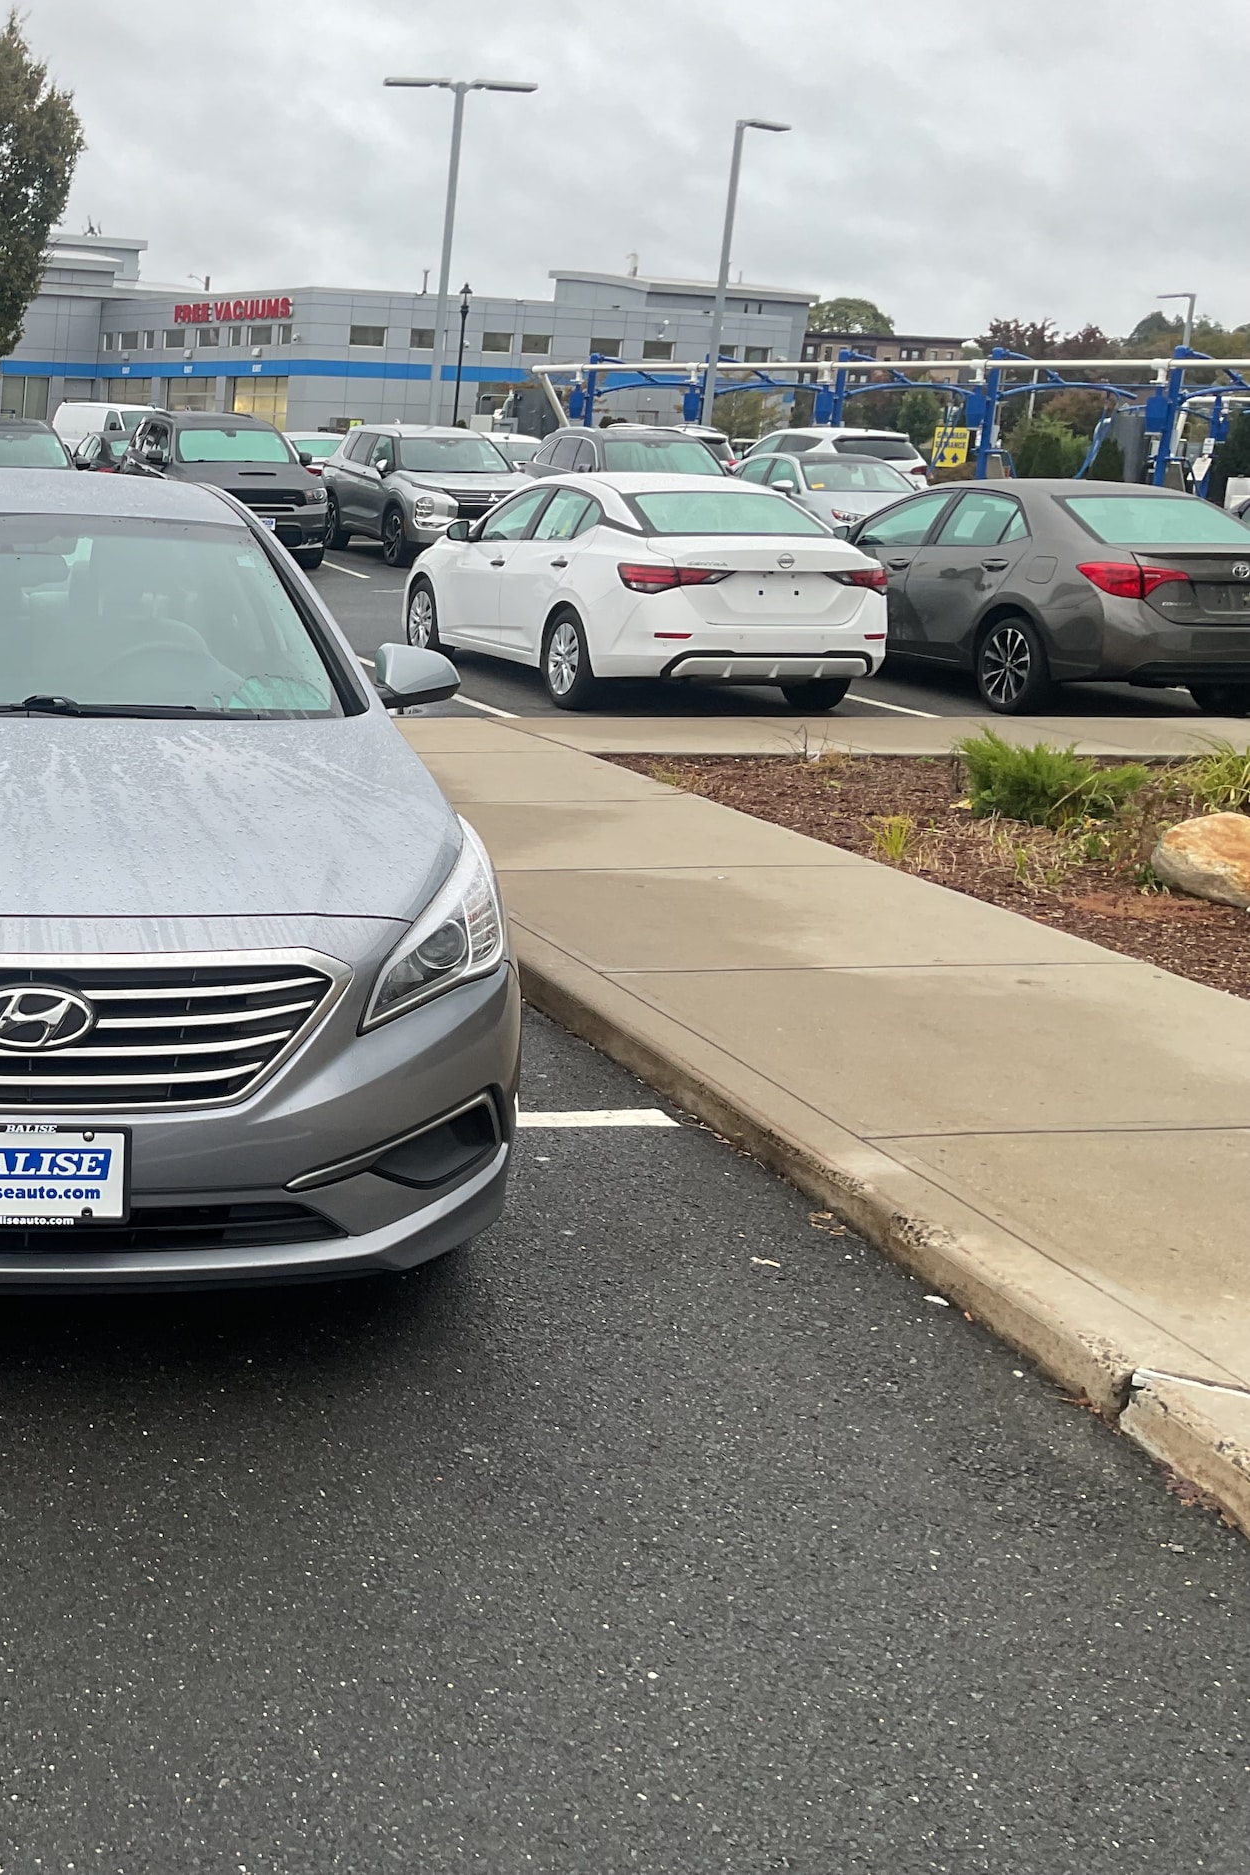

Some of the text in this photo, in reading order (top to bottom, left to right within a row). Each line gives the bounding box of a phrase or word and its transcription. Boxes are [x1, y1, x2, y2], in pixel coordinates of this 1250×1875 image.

[174, 297, 294, 323] FREE VACUUMS
[5, 1124, 58, 1134] BALISE
